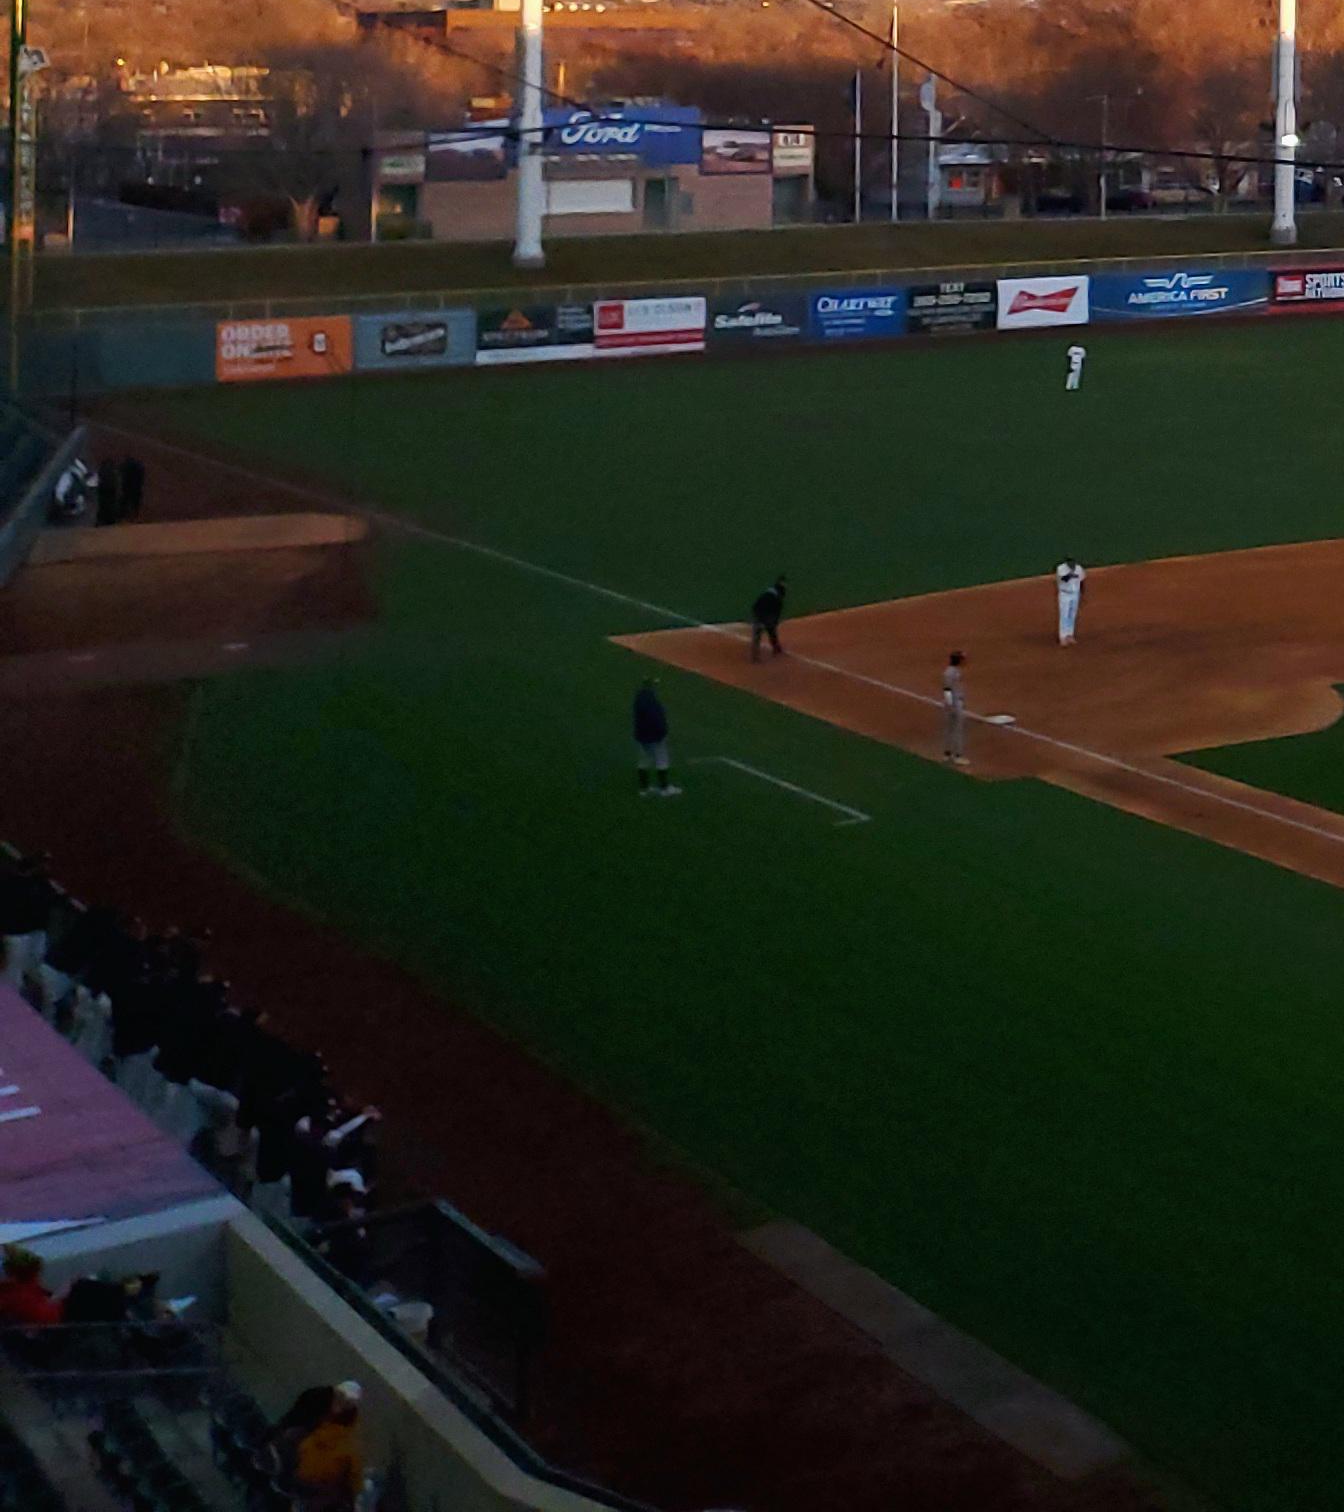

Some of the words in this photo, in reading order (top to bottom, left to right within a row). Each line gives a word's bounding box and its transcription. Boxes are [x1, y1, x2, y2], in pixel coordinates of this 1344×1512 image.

[562, 111, 642, 146] Ford
[1127, 290, 1188, 304] AMERICA
[1189, 287, 1229, 302] FIRST
